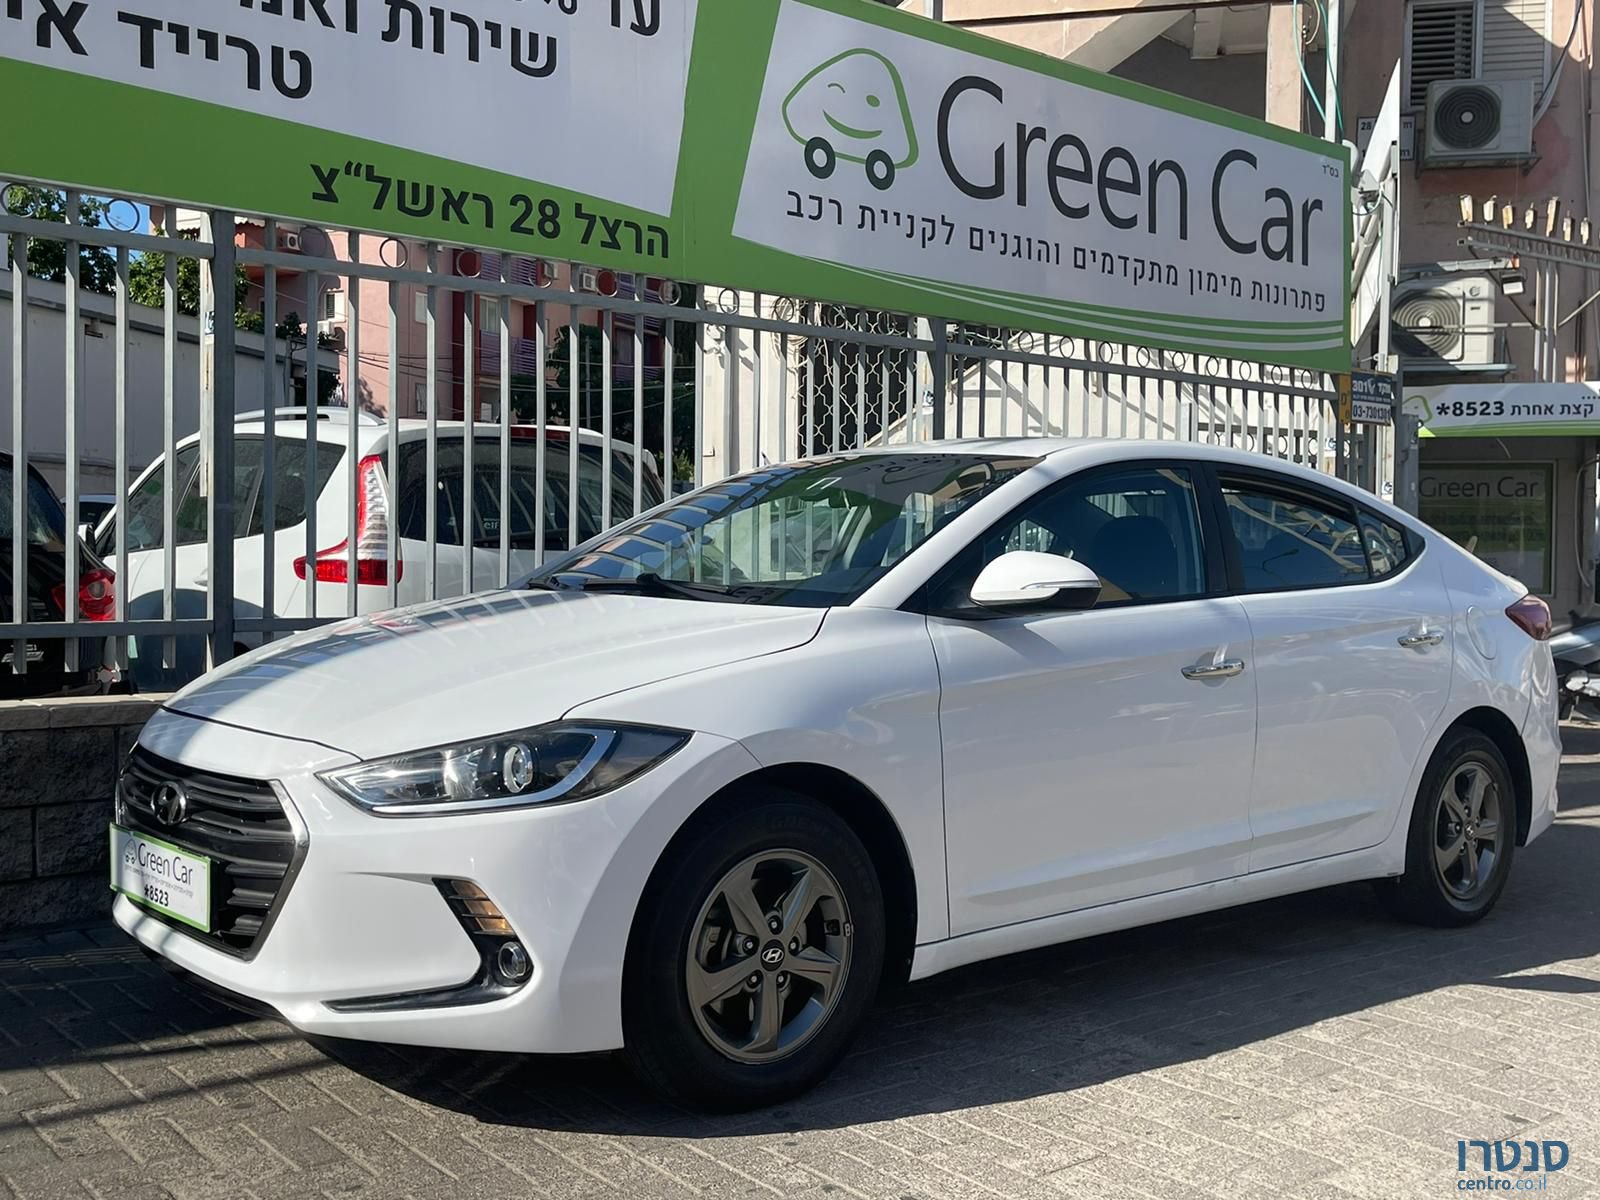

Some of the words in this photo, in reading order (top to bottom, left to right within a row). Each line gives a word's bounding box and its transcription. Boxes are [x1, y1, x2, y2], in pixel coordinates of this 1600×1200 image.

[117, 10, 313, 99] טרייד
[380, 0, 558, 78] שירות
[936, 75, 1189, 241] Green
[1211, 148, 1323, 267] Car
[509, 193, 561, 240] 28
[786, 190, 843, 225] רכב
[857, 204, 956, 249] לקניית
[574, 202, 669, 259] הרצל
[969, 226, 1061, 265] והוגנים
[1072, 246, 1179, 287] מתקדמים
[1187, 267, 1242, 298] מימון
[1250, 280, 1326, 313] פתרונות
[1510, 402, 1554, 417] אחרת
[1559, 403, 1595, 418] קצת
[1418, 476, 1490, 498] Green
[1497, 476, 1539, 498] Car
[138, 843, 170, 877] Green
[173, 857, 193, 885] Car
